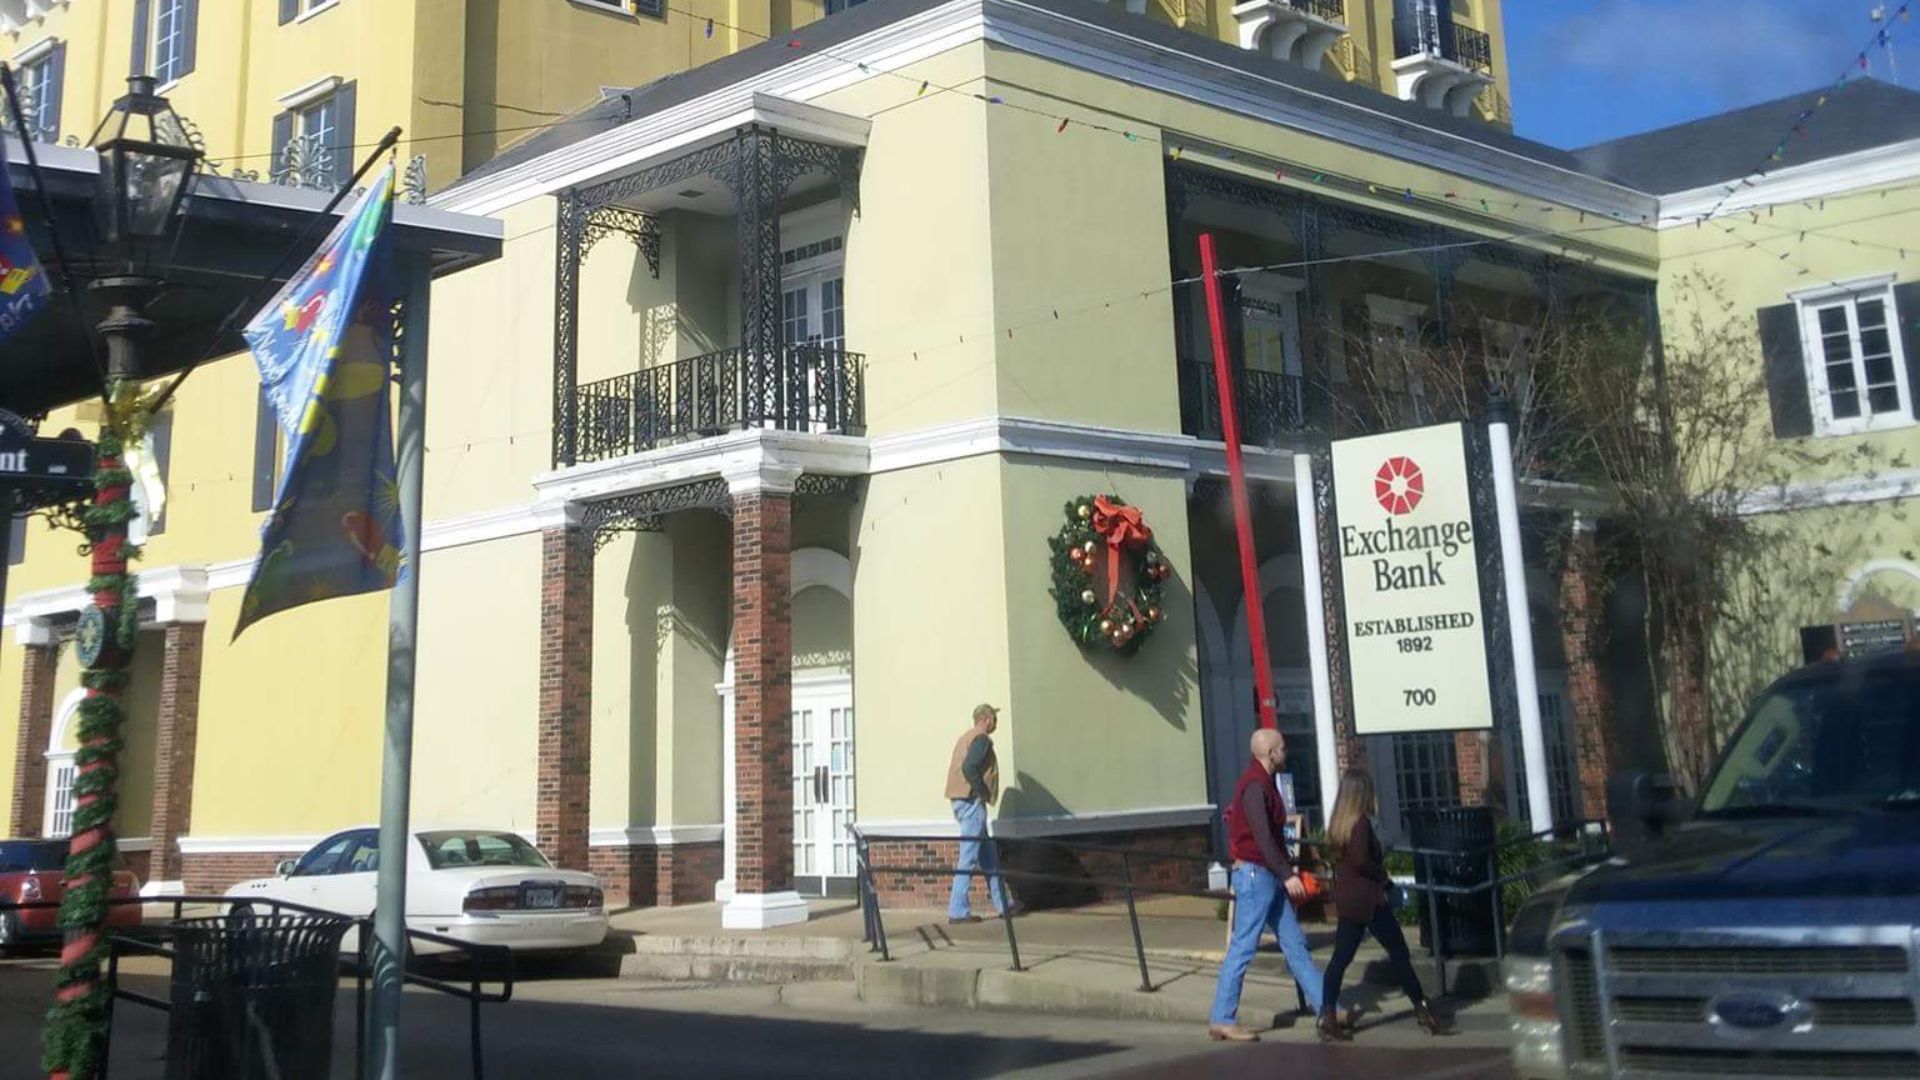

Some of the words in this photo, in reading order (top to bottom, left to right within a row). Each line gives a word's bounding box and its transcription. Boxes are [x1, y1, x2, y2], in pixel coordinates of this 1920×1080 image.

[1341, 517, 1472, 557] Exchange
[1372, 550, 1446, 592] Bank
[1354, 612, 1475, 637] ESTABLISHED
[1397, 636, 1433, 653] 1892
[1403, 688, 1436, 706] 700
